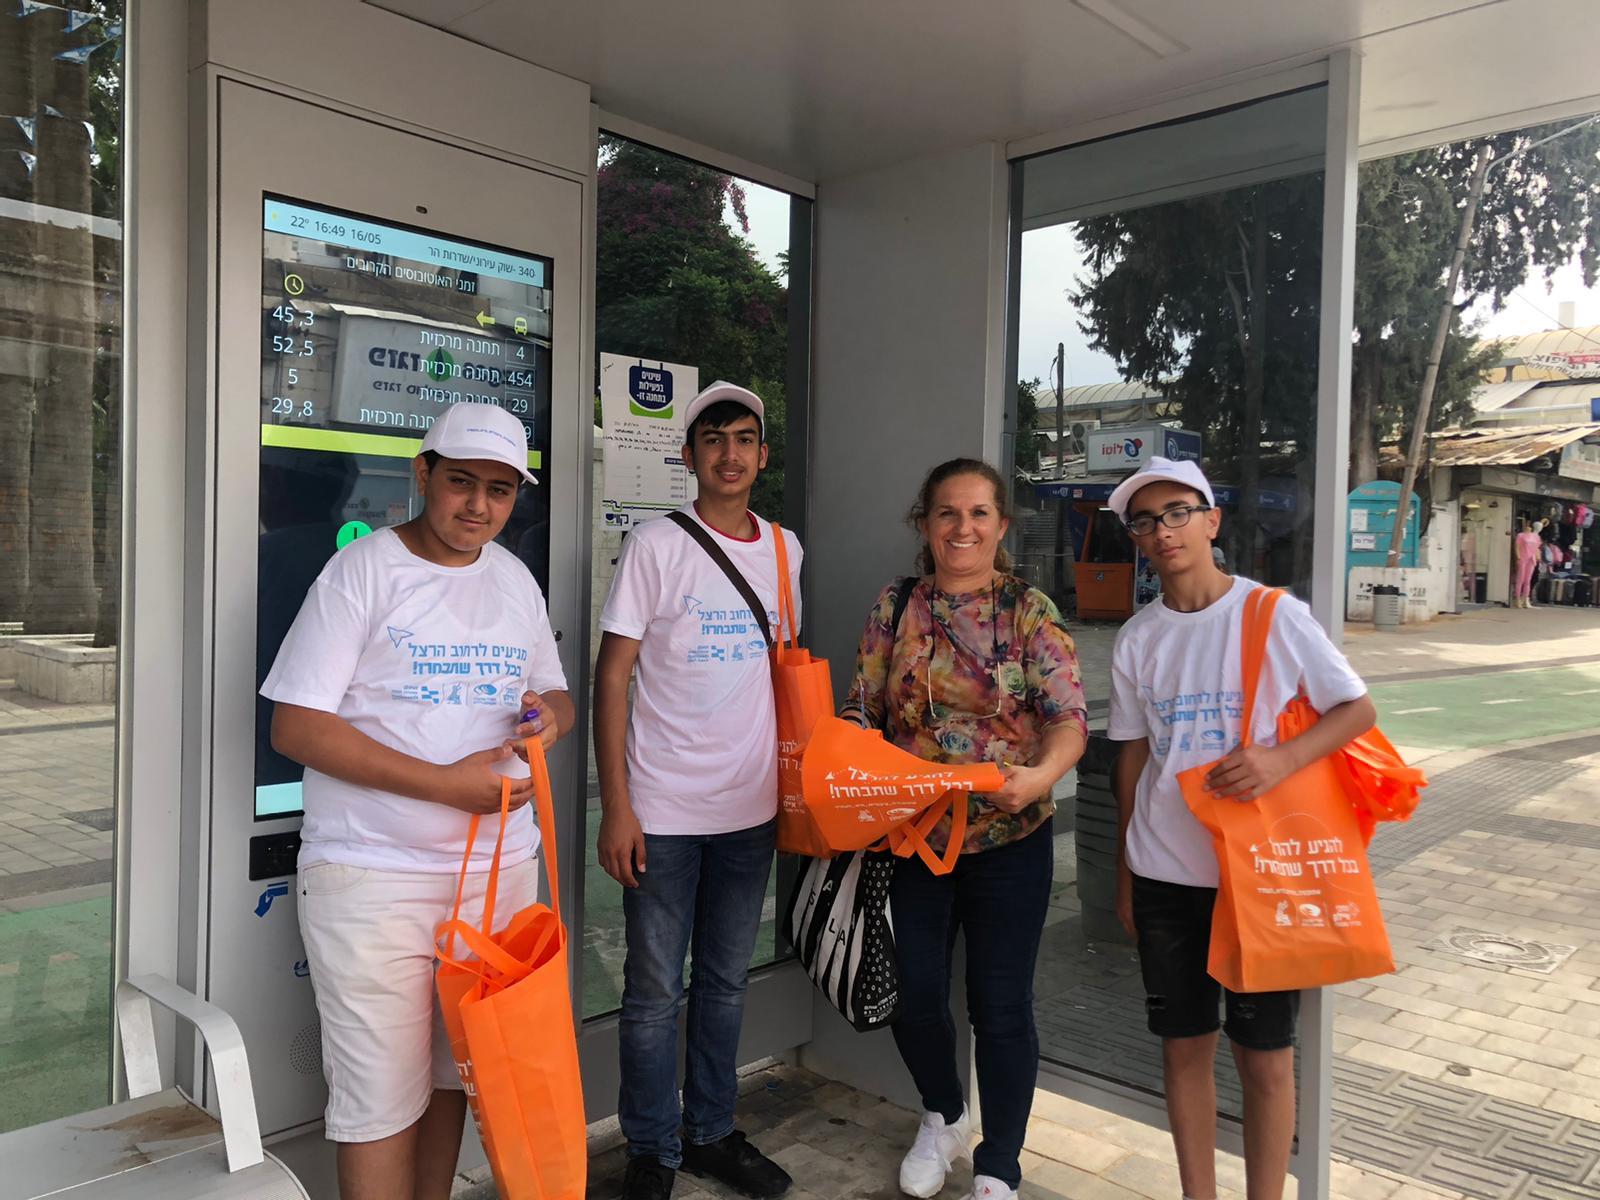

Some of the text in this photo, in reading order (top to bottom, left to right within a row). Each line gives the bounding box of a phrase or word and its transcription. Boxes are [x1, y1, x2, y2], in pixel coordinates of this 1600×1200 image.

[290, 215, 382, 245] 22° 16:49 16/05
[346, 256, 476, 293] זמני האוטובוסים הקרובים
[518, 266, 536, 279] 340
[272, 306, 294, 323] 45
[272, 335, 294, 354] 52
[420, 330, 525, 360] 4 תחנה מרכזית
[288, 368, 298, 385] 5
[420, 358, 462, 378] מרכזית
[465, 365, 500, 384] תחנה
[507, 373, 533, 388] 454
[272, 396, 293, 414] 29
[511, 398, 528, 414] 29
[360, 407, 405, 426] מרכזית
[409, 414, 440, 430] חנה
[1102, 442, 1123, 456] לוטו
[698, 609, 727, 621] הרצל
[702, 623, 746, 635] שתבחרו!
[408, 642, 528, 661] מגיעים לרחוב הרצל
[412, 661, 522, 677] בכל דרך שתבחרו!
[829, 783, 898, 799] שתבחרו!
[902, 783, 935, 797] דרך
[1305, 860, 1336, 878] דרך
